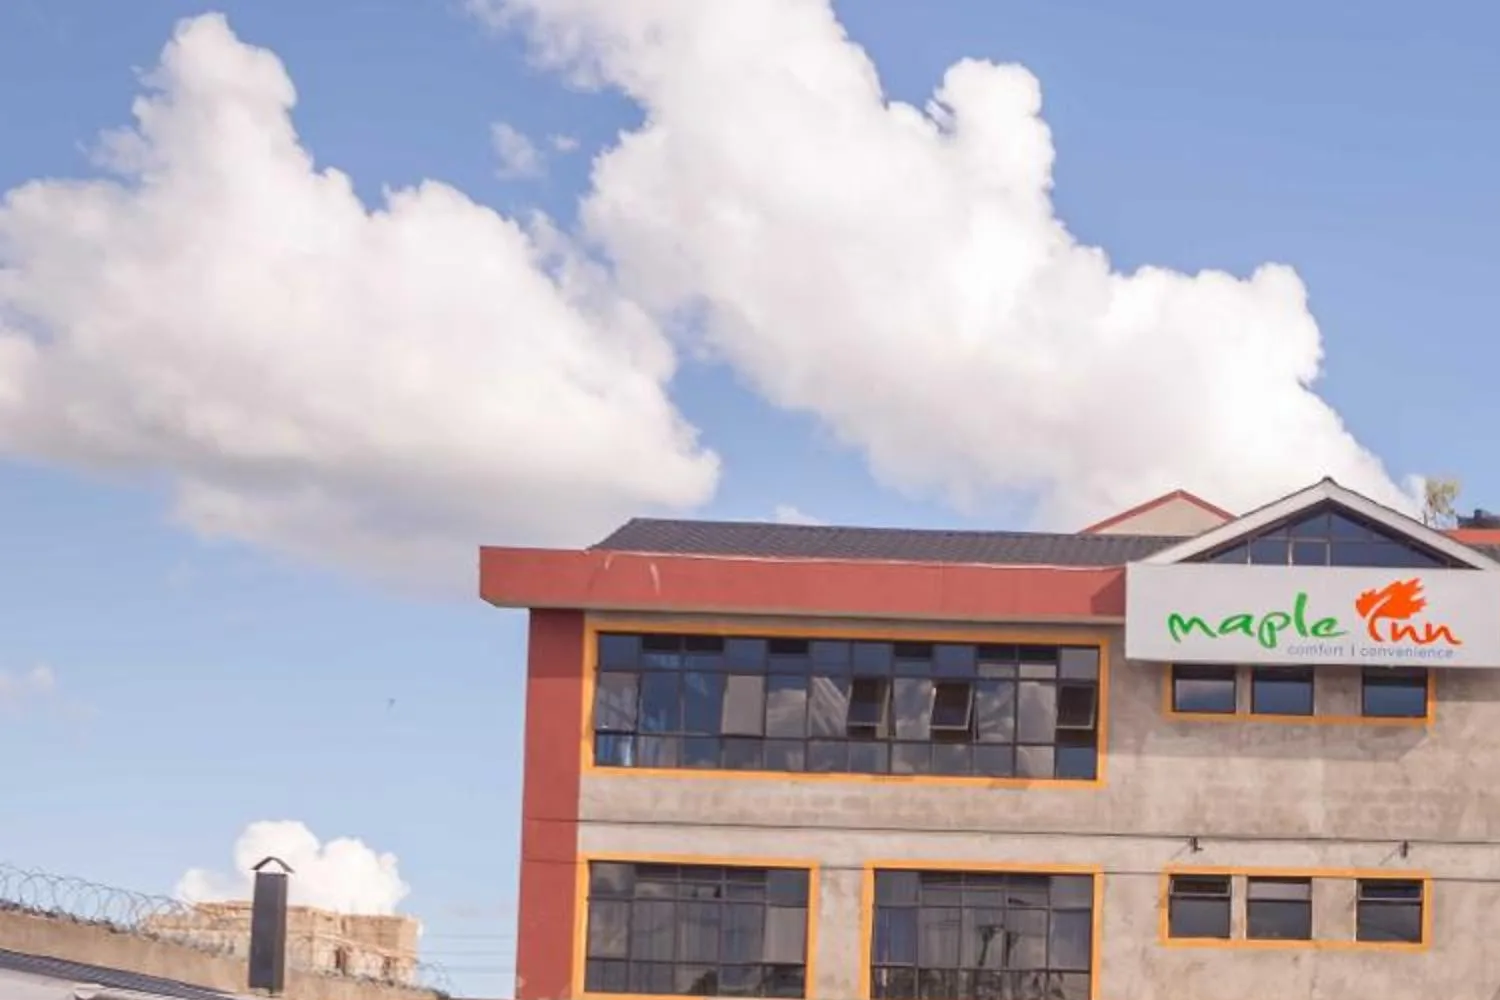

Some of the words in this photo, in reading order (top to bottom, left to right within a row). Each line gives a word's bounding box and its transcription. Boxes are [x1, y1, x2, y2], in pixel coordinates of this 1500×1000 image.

[1168, 592, 1349, 648] maple
[1287, 644, 1344, 657] comfort
[1359, 646, 1455, 659] convenience
